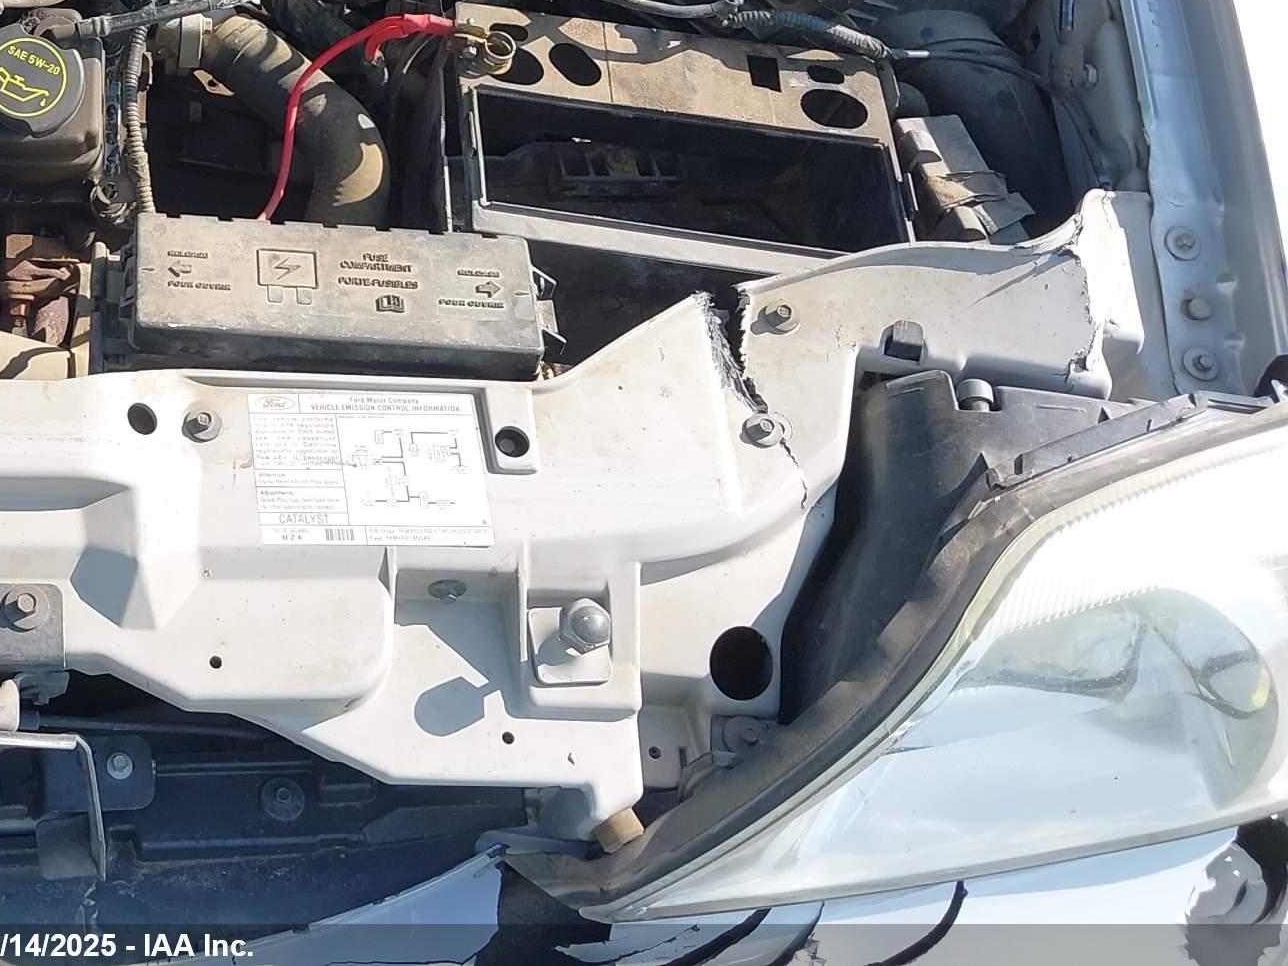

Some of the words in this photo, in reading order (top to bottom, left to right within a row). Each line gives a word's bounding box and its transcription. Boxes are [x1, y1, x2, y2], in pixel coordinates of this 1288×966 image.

[7, 45, 28, 61] SAE
[28, 55, 61, 75] 5W-20
[362, 253, 388, 262] FUSE
[339, 261, 413, 273] COMPARTMENT
[167, 280, 194, 289] POUR
[338, 277, 419, 289] PORTE-FUSIBLES
[438, 298, 465, 306] POUR
[388, 397, 420, 405] Company
[310, 403, 339, 411] VEHICLE
[377, 404, 410, 412] CONTROL
[279, 514, 330, 524] CATALYST
